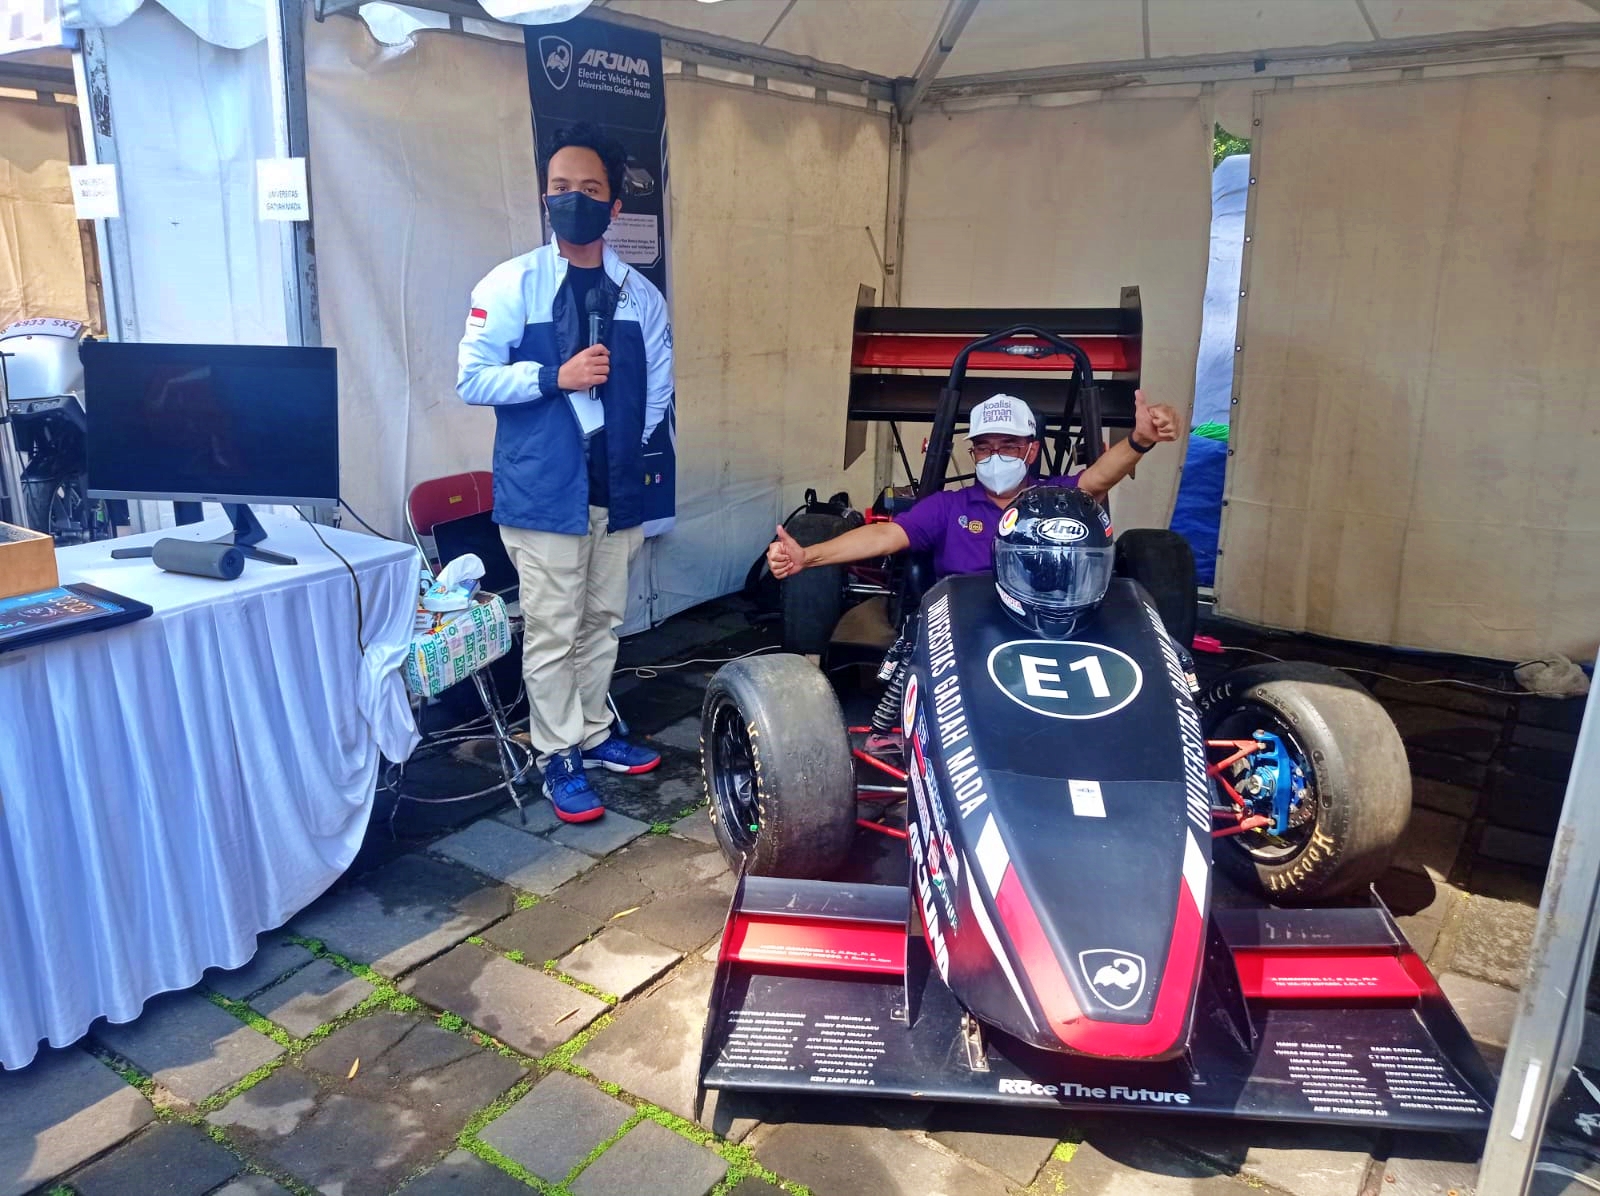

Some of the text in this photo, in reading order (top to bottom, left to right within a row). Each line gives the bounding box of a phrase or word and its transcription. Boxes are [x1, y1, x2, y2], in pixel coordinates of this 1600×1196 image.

[578, 48, 650, 78] ARJUNA
[578, 67, 651, 89] Electric Vehicle Team
[578, 79, 651, 99] Universitas Gadjah Mada
[983, 399, 1012, 411] koalisi
[983, 408, 1012, 418] teman
[1041, 520, 1083, 536] Arai
[927, 593, 956, 678] UNIVERSITAS
[1019, 654, 1111, 699] E1
[933, 675, 969, 750] GADJAH
[1175, 698, 1212, 833] UNIVERSITAS
[946, 745, 988, 820] MADA
[999, 1078, 1191, 1105] Race The Future
